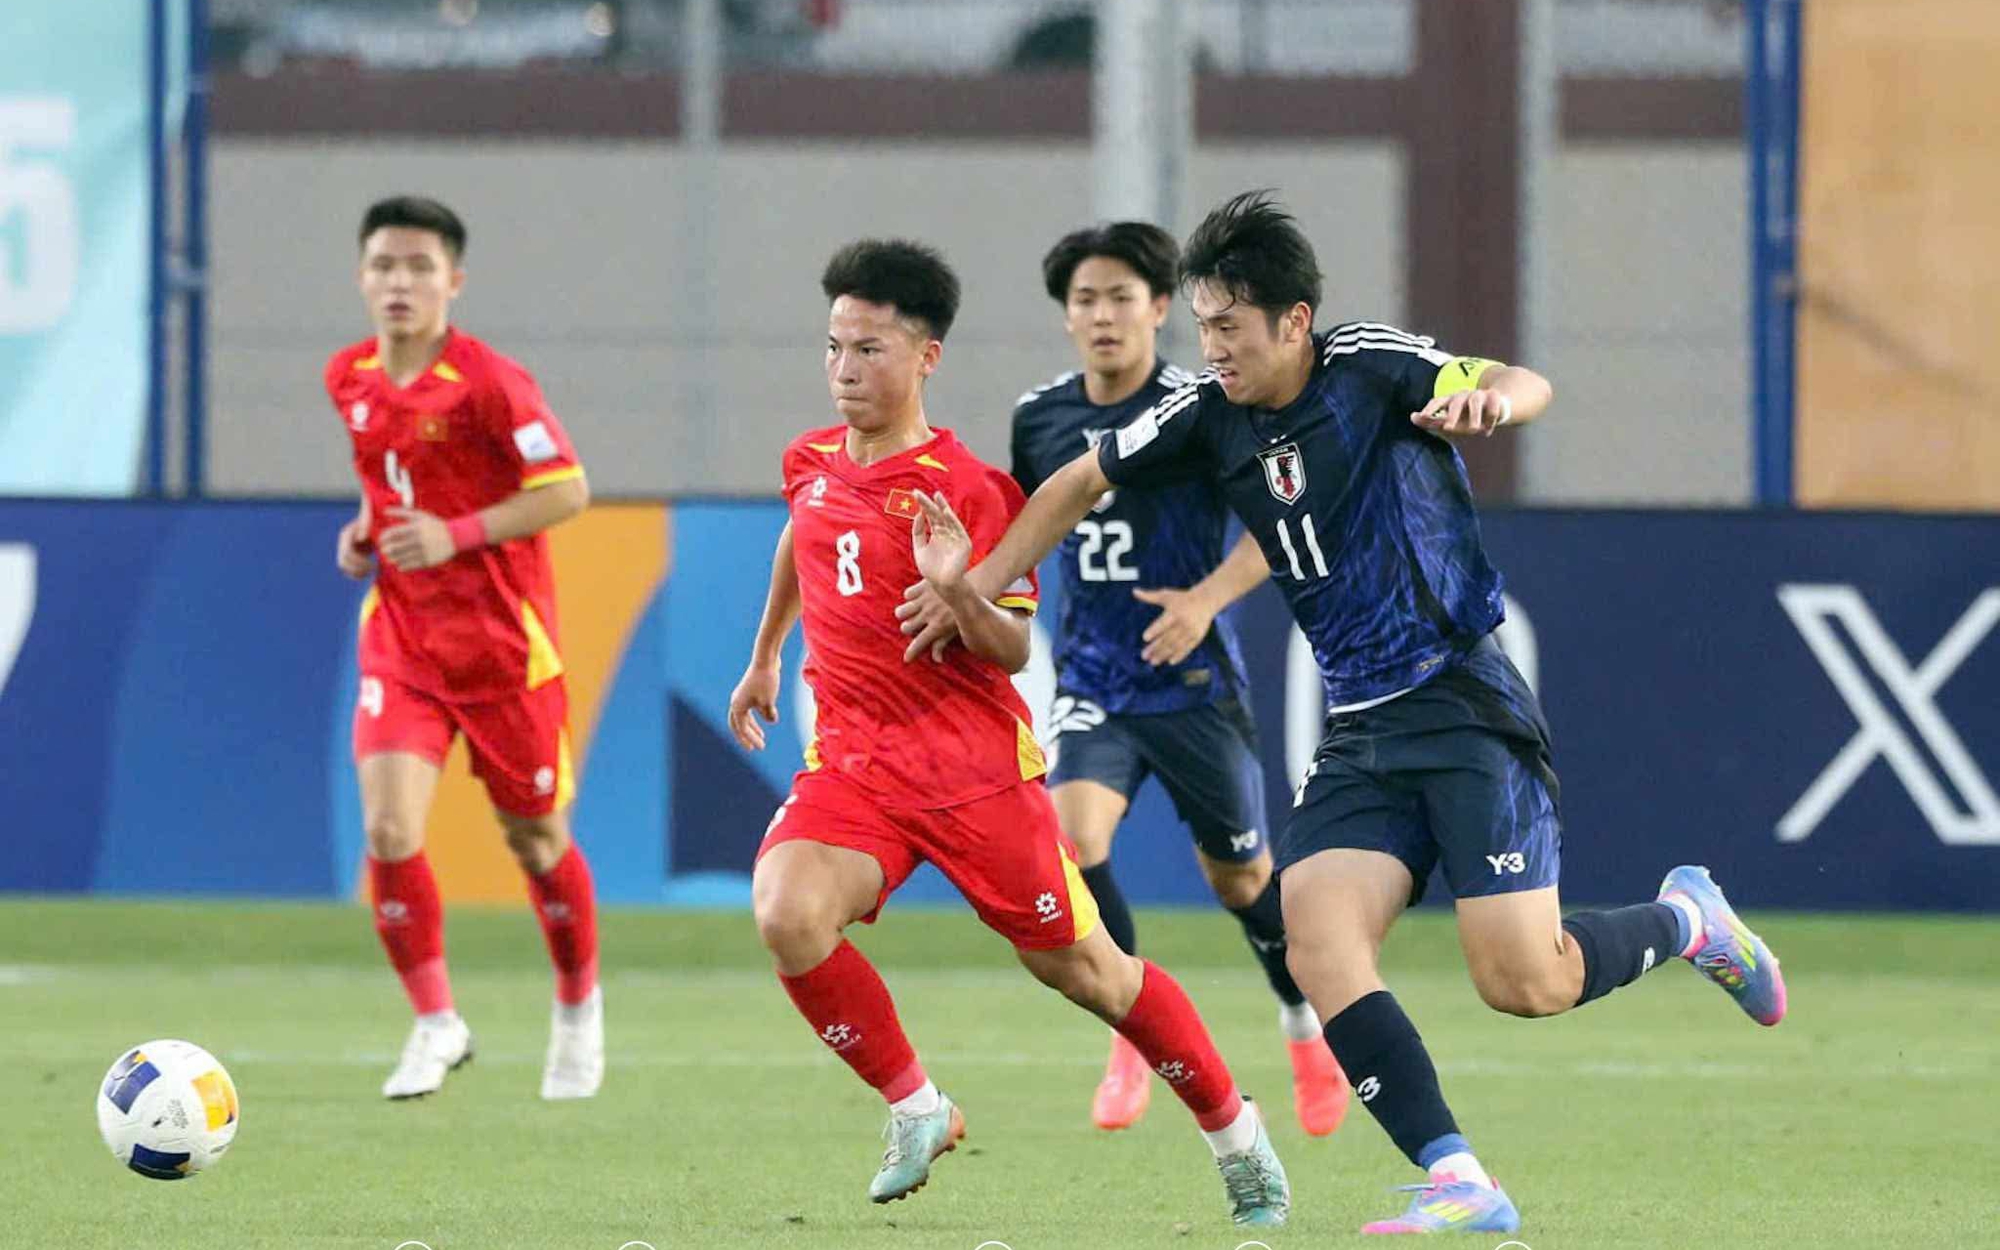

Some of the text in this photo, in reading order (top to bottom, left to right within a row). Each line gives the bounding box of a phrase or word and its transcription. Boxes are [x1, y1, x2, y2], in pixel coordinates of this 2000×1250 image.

[834, 531, 863, 597] 8
[1076, 520, 1139, 581] 22
[1273, 513, 1329, 581] 11
[1486, 852, 1526, 876] Y-3
